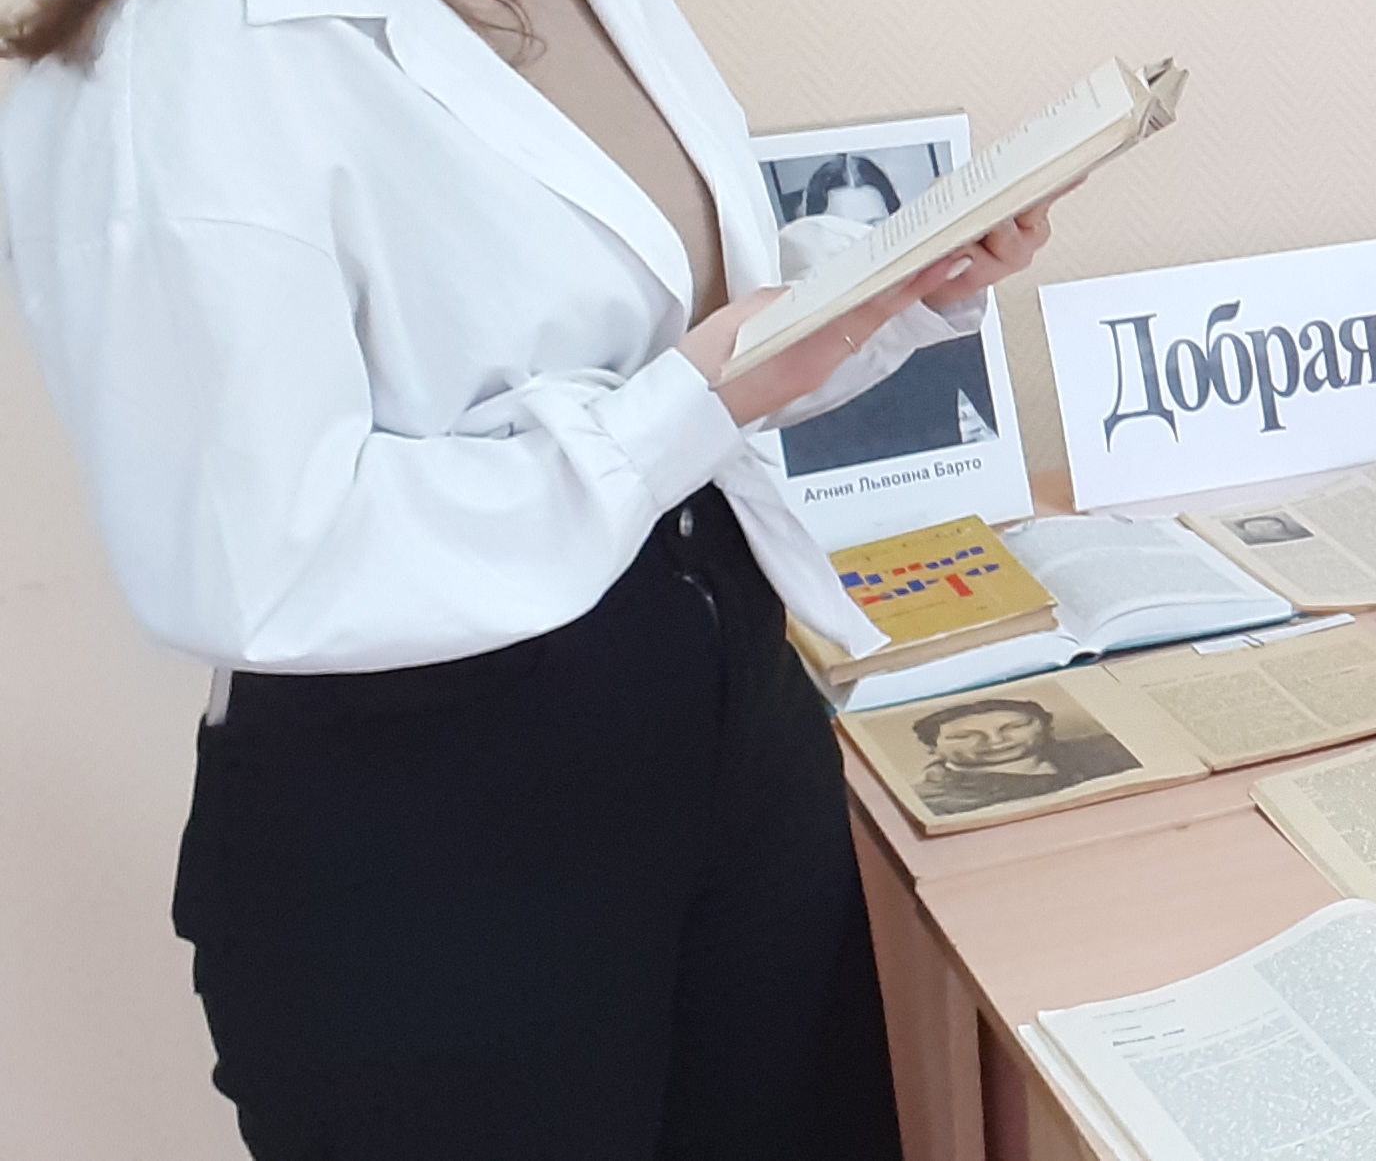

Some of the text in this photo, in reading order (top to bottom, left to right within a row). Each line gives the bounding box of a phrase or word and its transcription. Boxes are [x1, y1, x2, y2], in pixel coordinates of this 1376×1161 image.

[803, 456, 983, 504] Агния Львовна Барто
